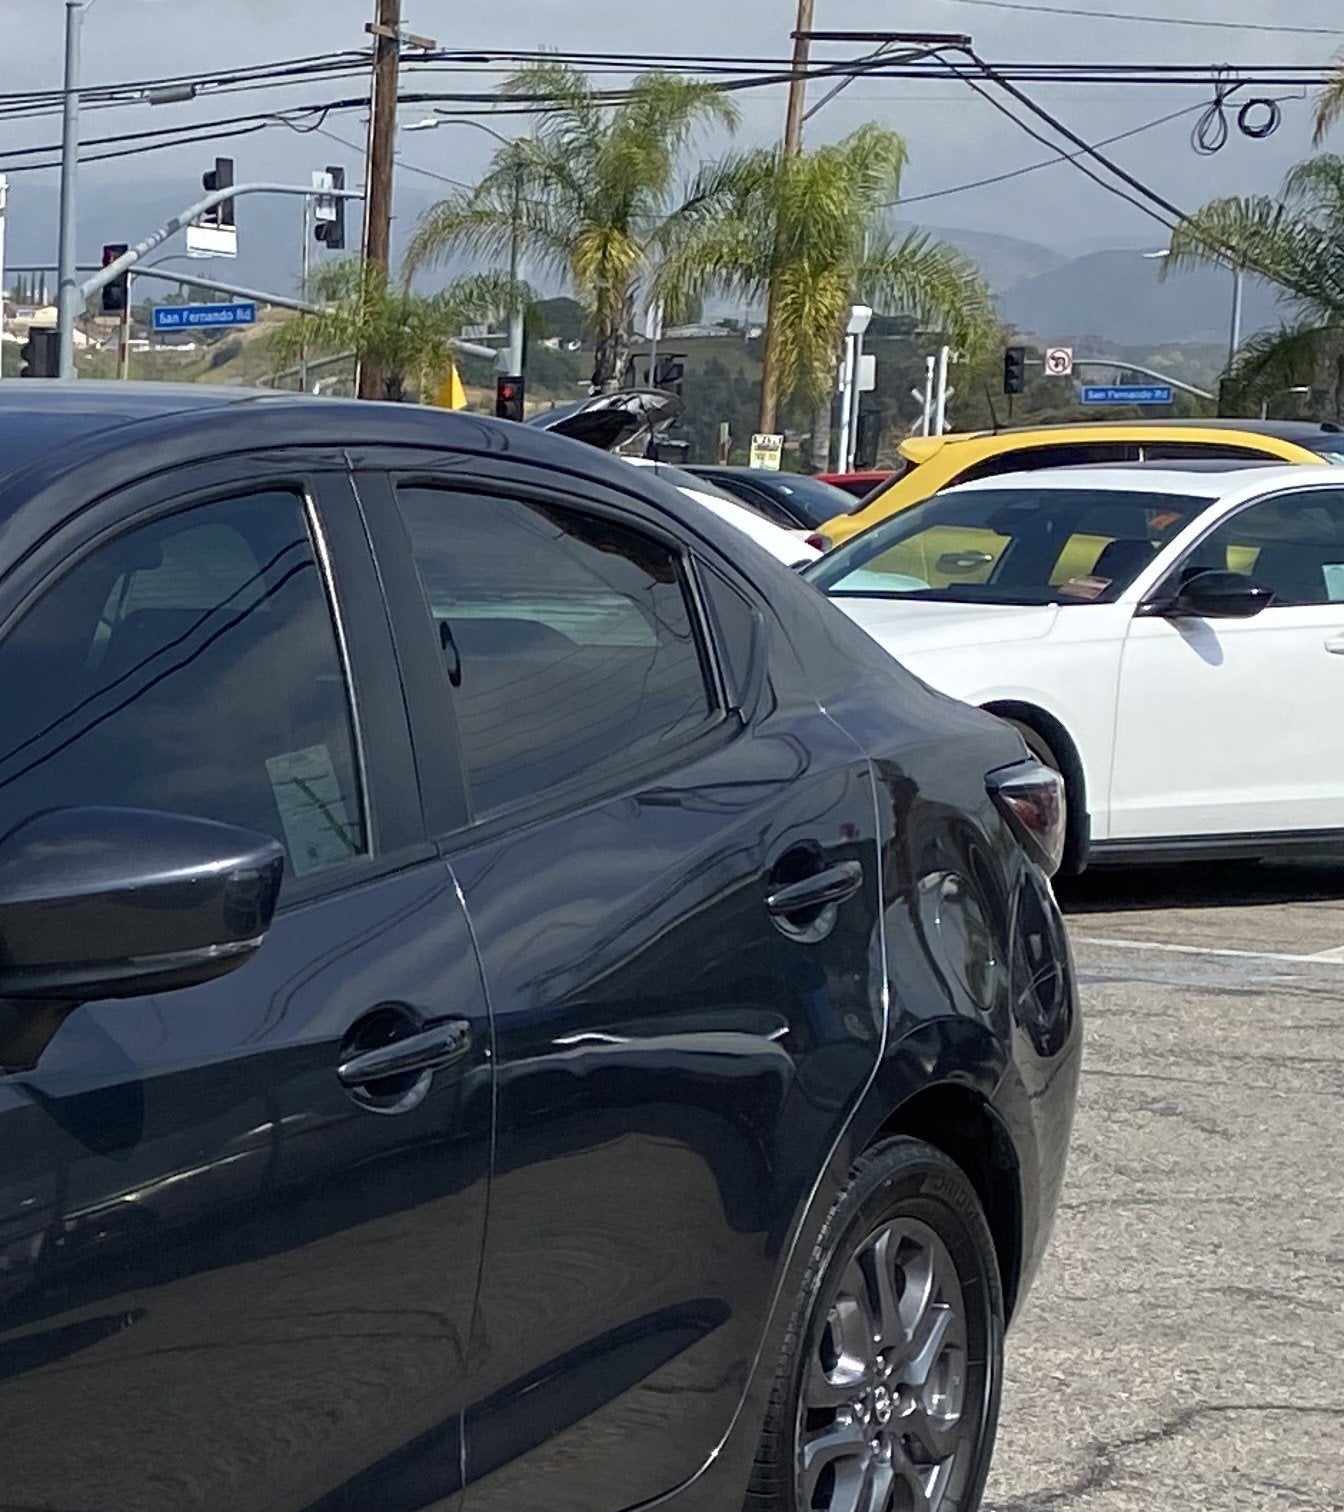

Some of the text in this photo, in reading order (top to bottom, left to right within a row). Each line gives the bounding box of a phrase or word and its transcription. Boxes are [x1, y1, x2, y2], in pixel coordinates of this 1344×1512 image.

[158, 307, 252, 324] San Fernando Rd
